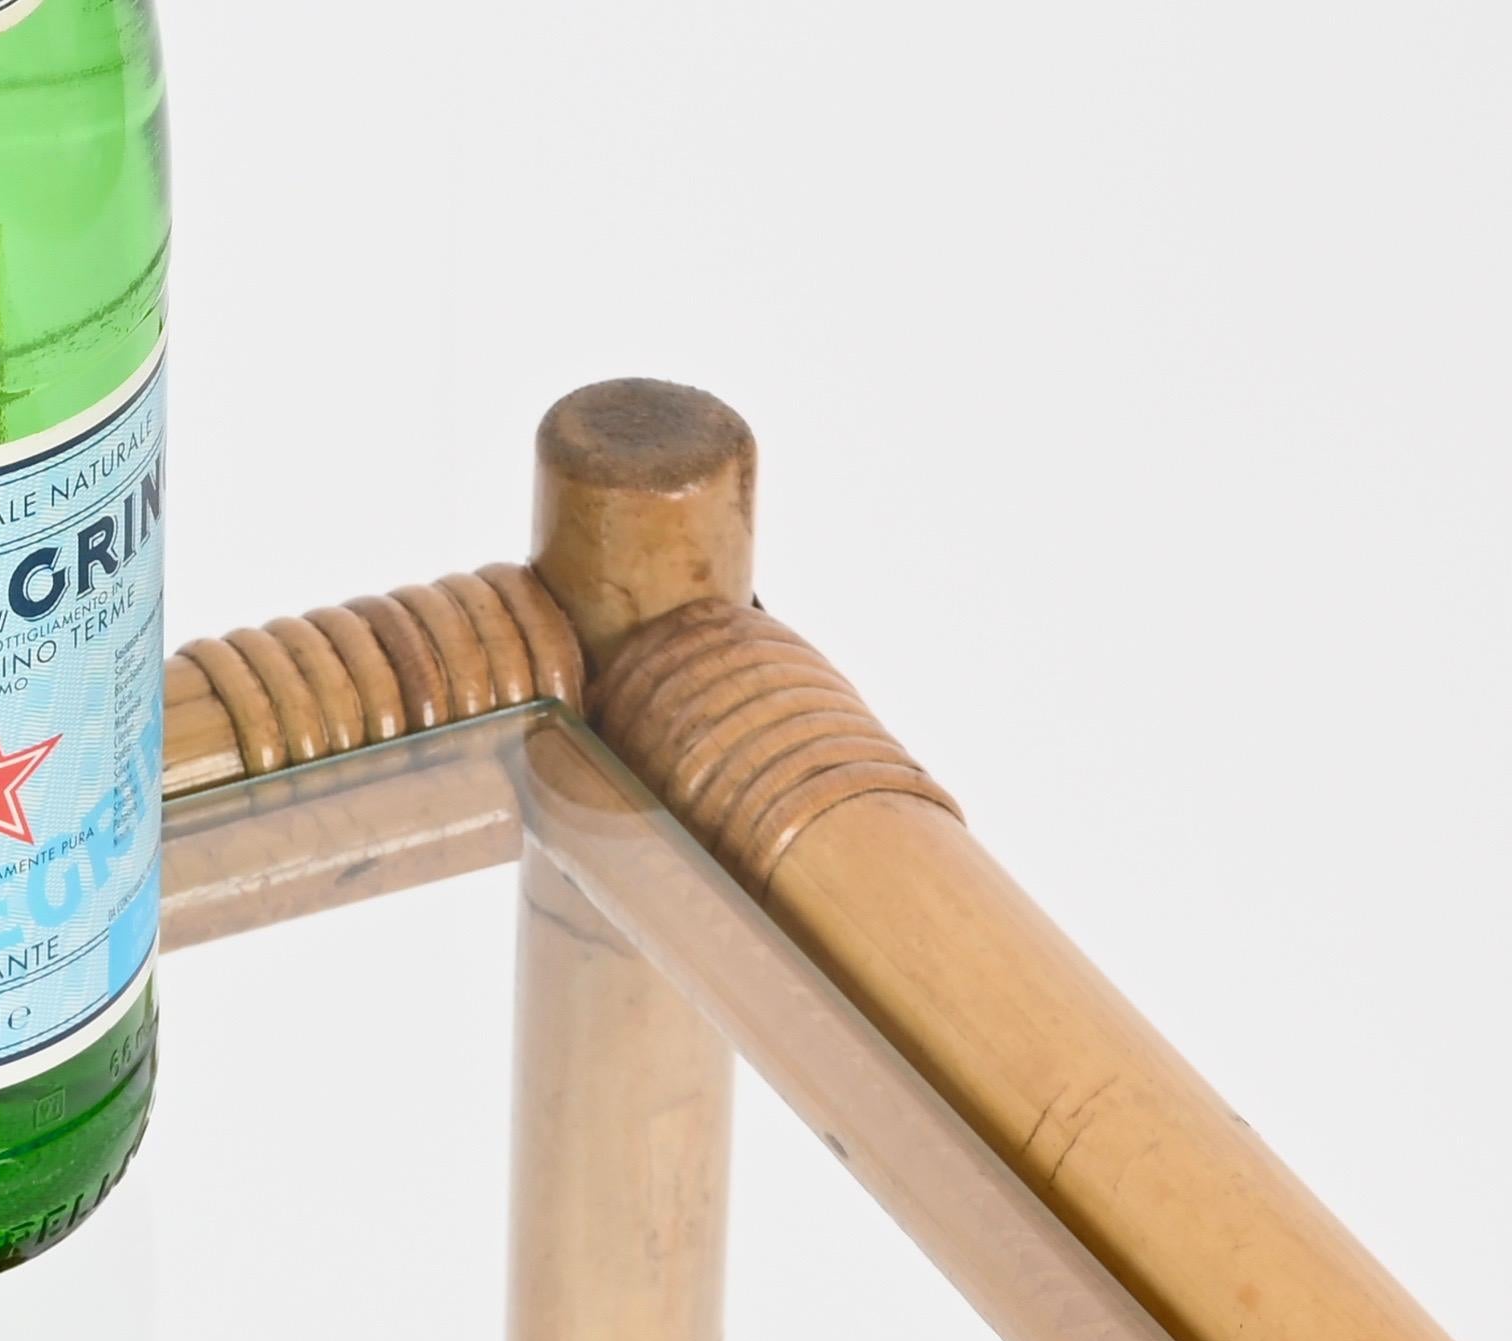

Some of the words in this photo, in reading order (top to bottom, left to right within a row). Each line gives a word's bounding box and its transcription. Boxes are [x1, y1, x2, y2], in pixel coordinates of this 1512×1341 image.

[50, 409, 153, 506] NATURALE
[111, 577, 124, 597] IN
[70, 582, 137, 649] TERME
[60, 826, 96, 856] PURA
